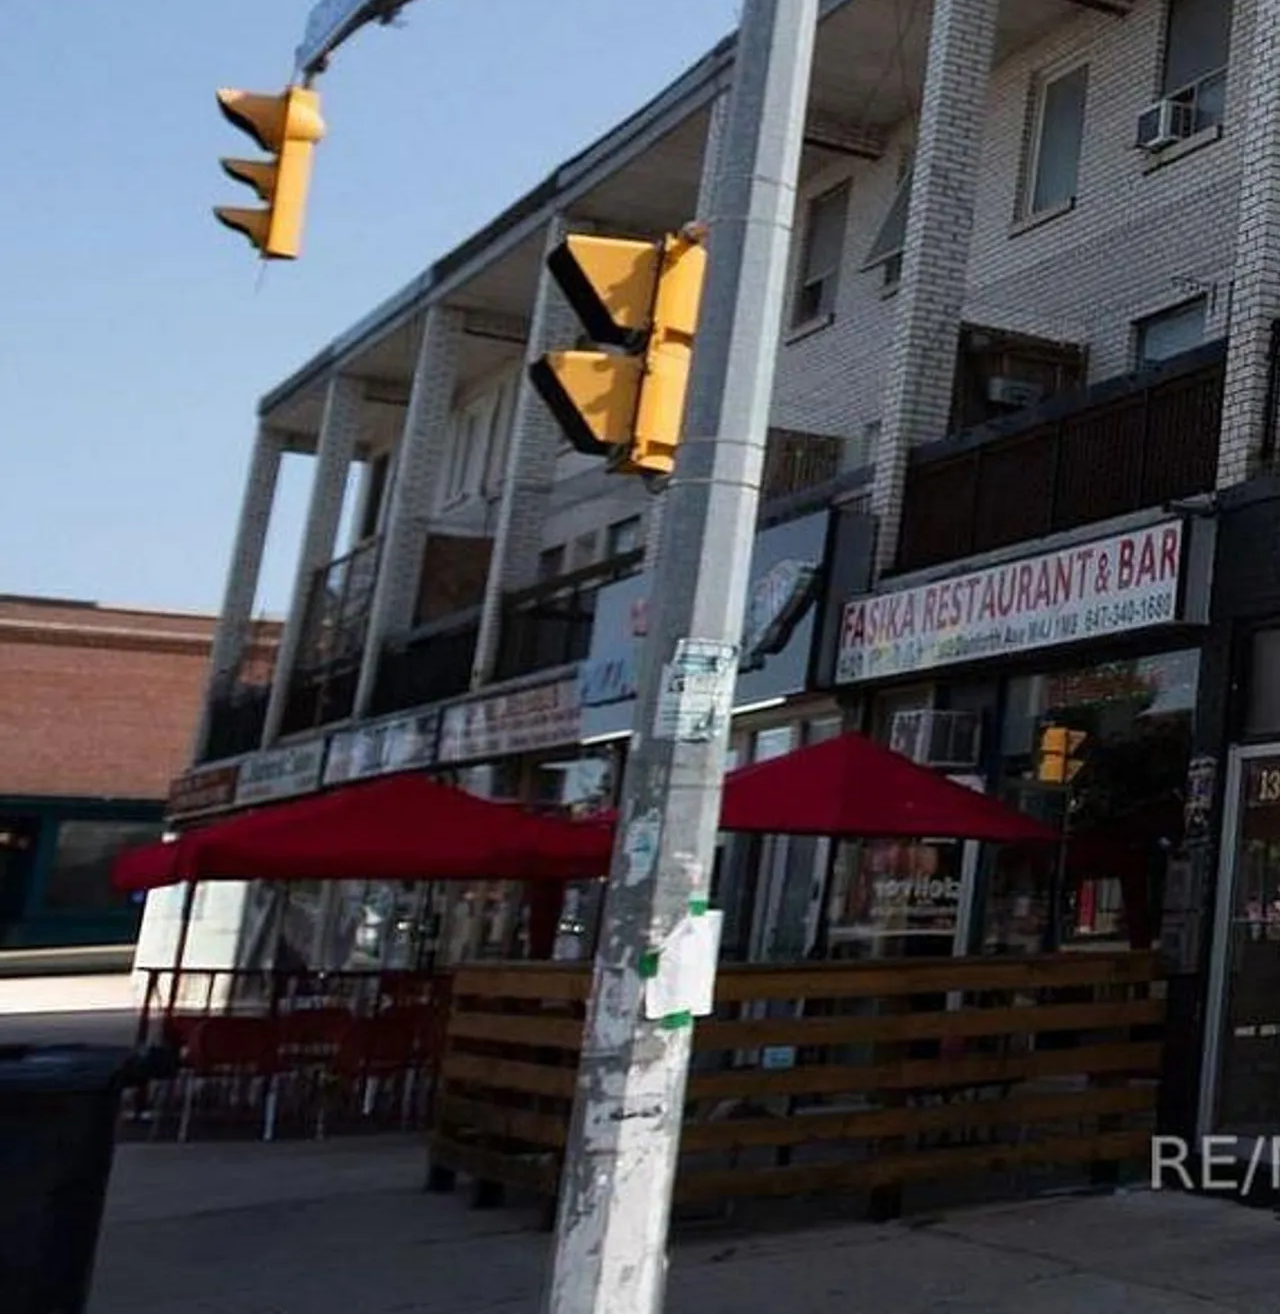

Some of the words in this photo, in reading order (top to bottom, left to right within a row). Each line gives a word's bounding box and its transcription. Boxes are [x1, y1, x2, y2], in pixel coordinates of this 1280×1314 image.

[841, 591, 916, 649] FASIKA
[922, 549, 1094, 633] RESTAURANT
[1095, 552, 1112, 594] &
[1118, 528, 1178, 590] BAR
